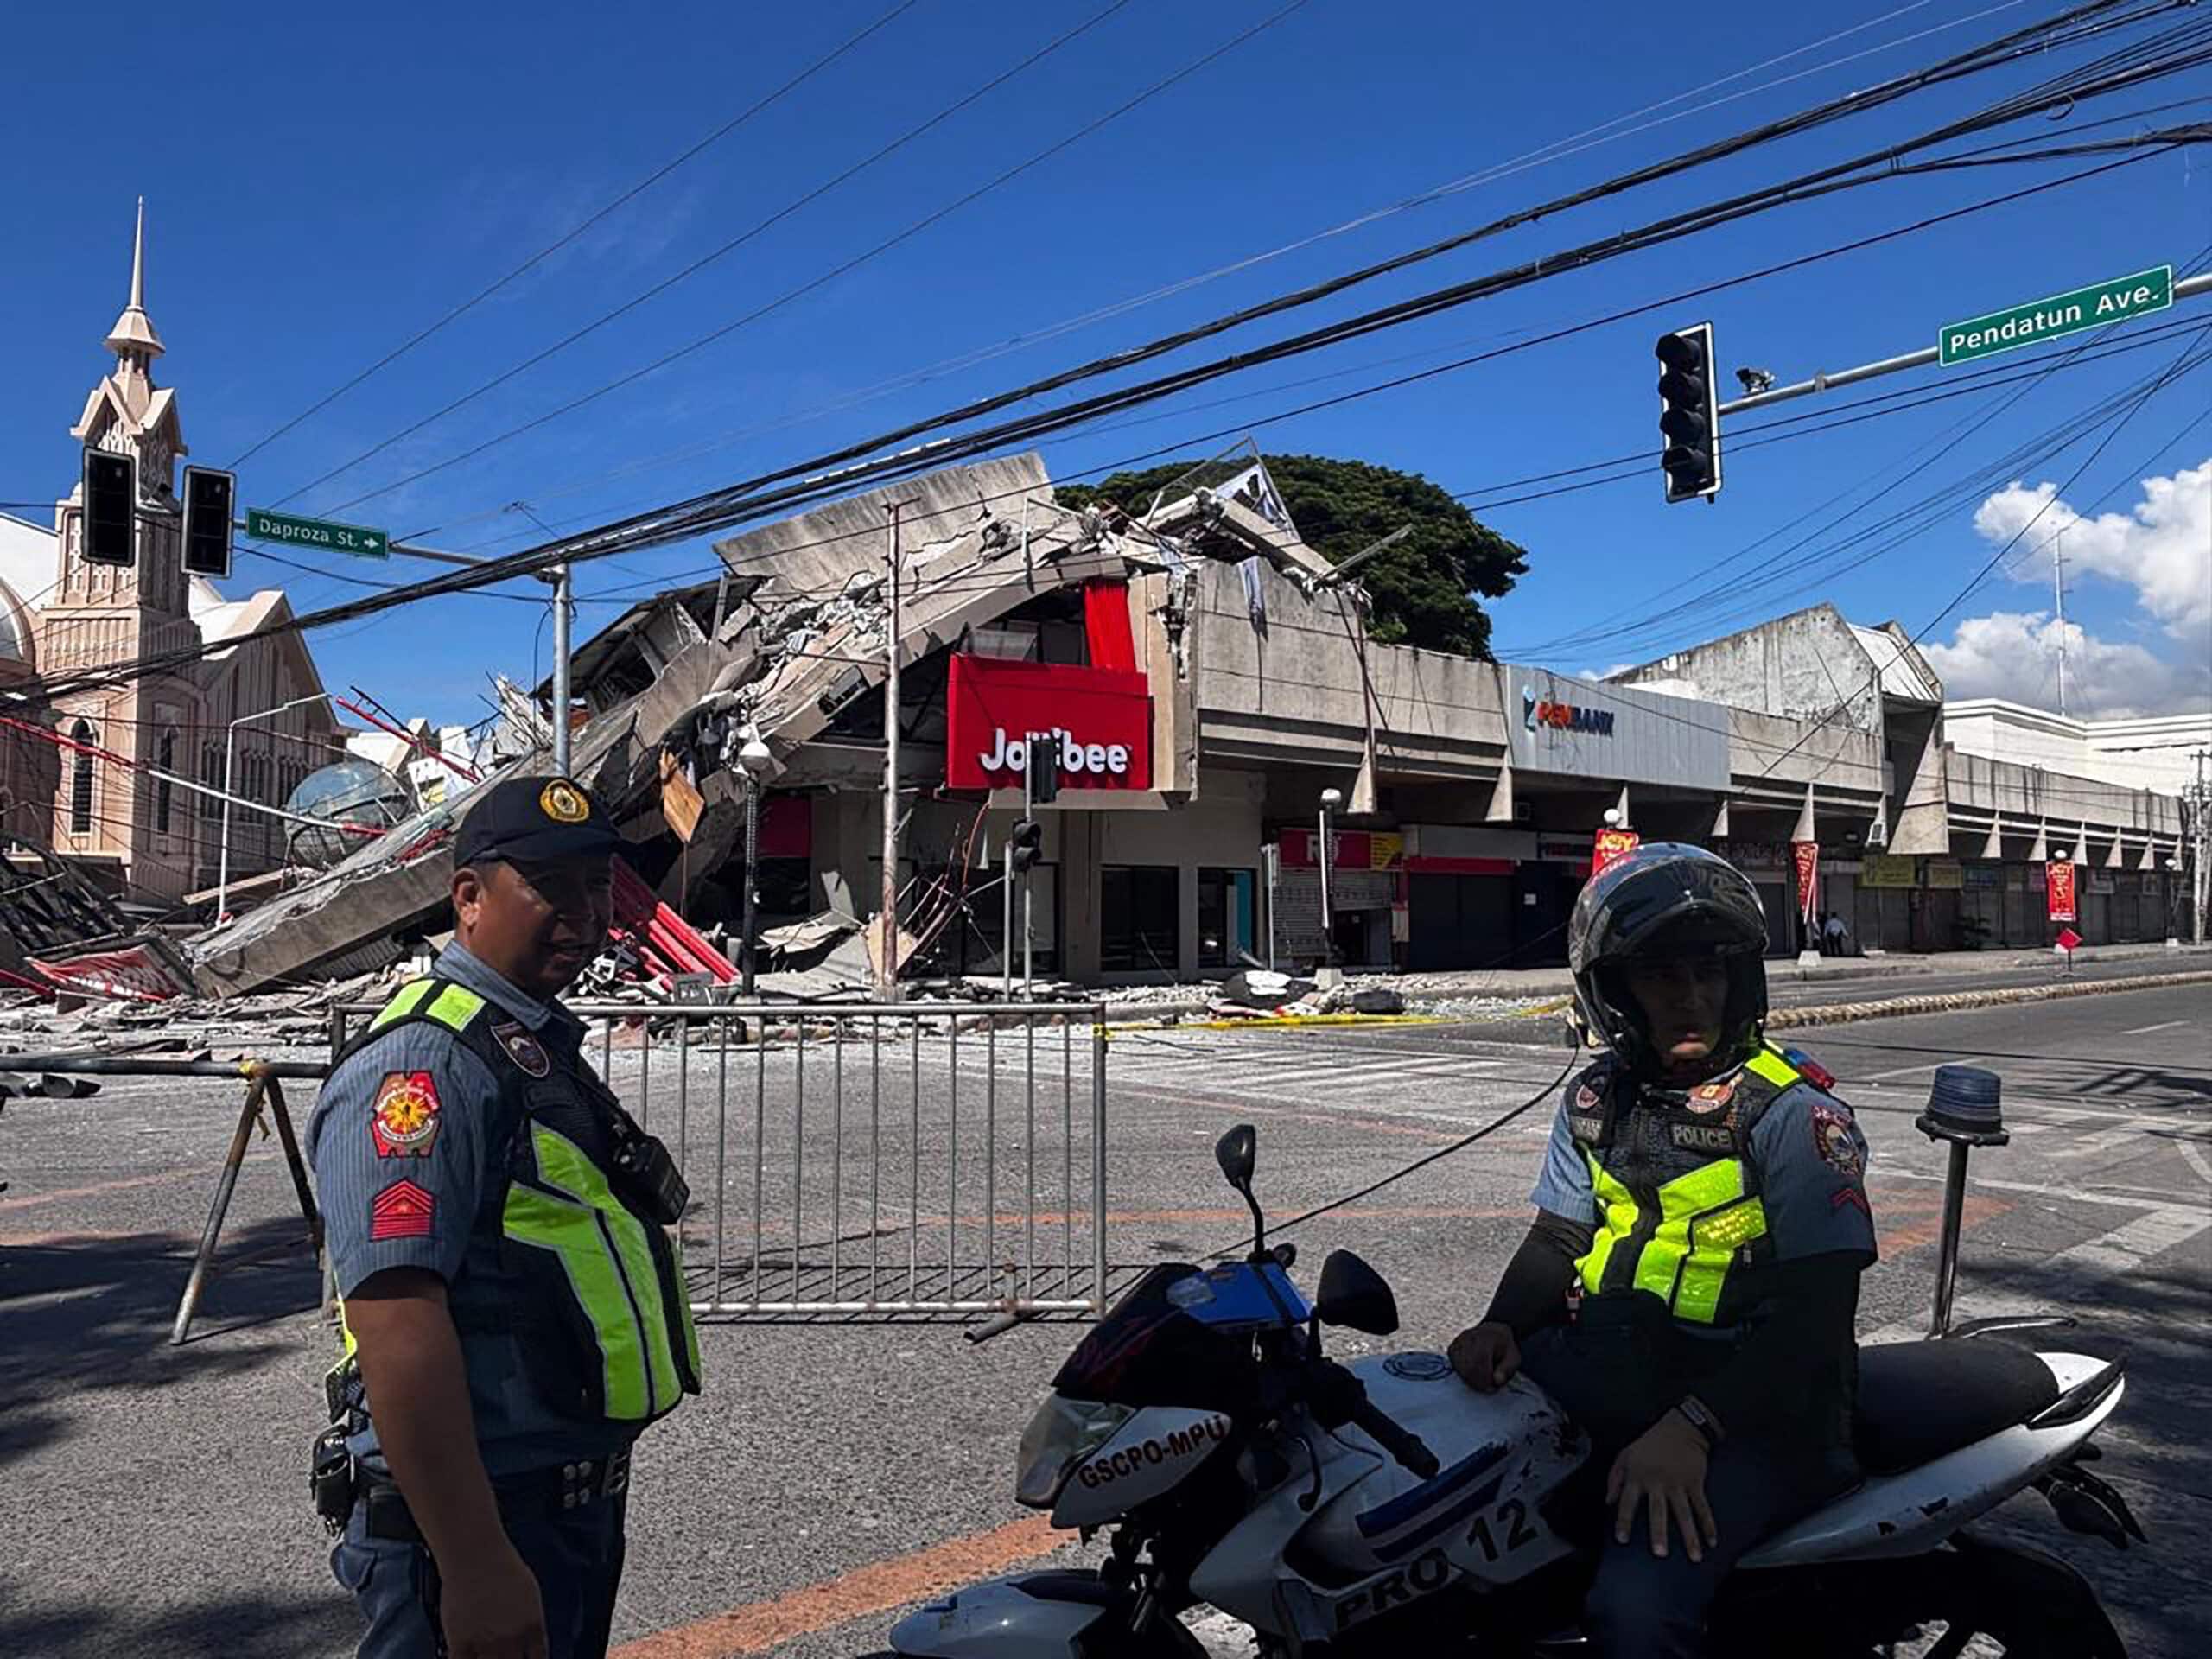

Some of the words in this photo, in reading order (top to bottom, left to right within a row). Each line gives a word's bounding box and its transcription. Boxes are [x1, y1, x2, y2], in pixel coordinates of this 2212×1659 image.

[1949, 305, 2082, 354] Pendatun
[2095, 285, 2160, 315] Ave.
[259, 518, 330, 543] Daproza
[337, 531, 358, 547] St.
[1673, 1125, 1729, 1147] POLICE
[1078, 1414, 1226, 1489] GSCPO-MPU
[1334, 1547, 1450, 1631] PRO
[1466, 1497, 1539, 1563] 12
